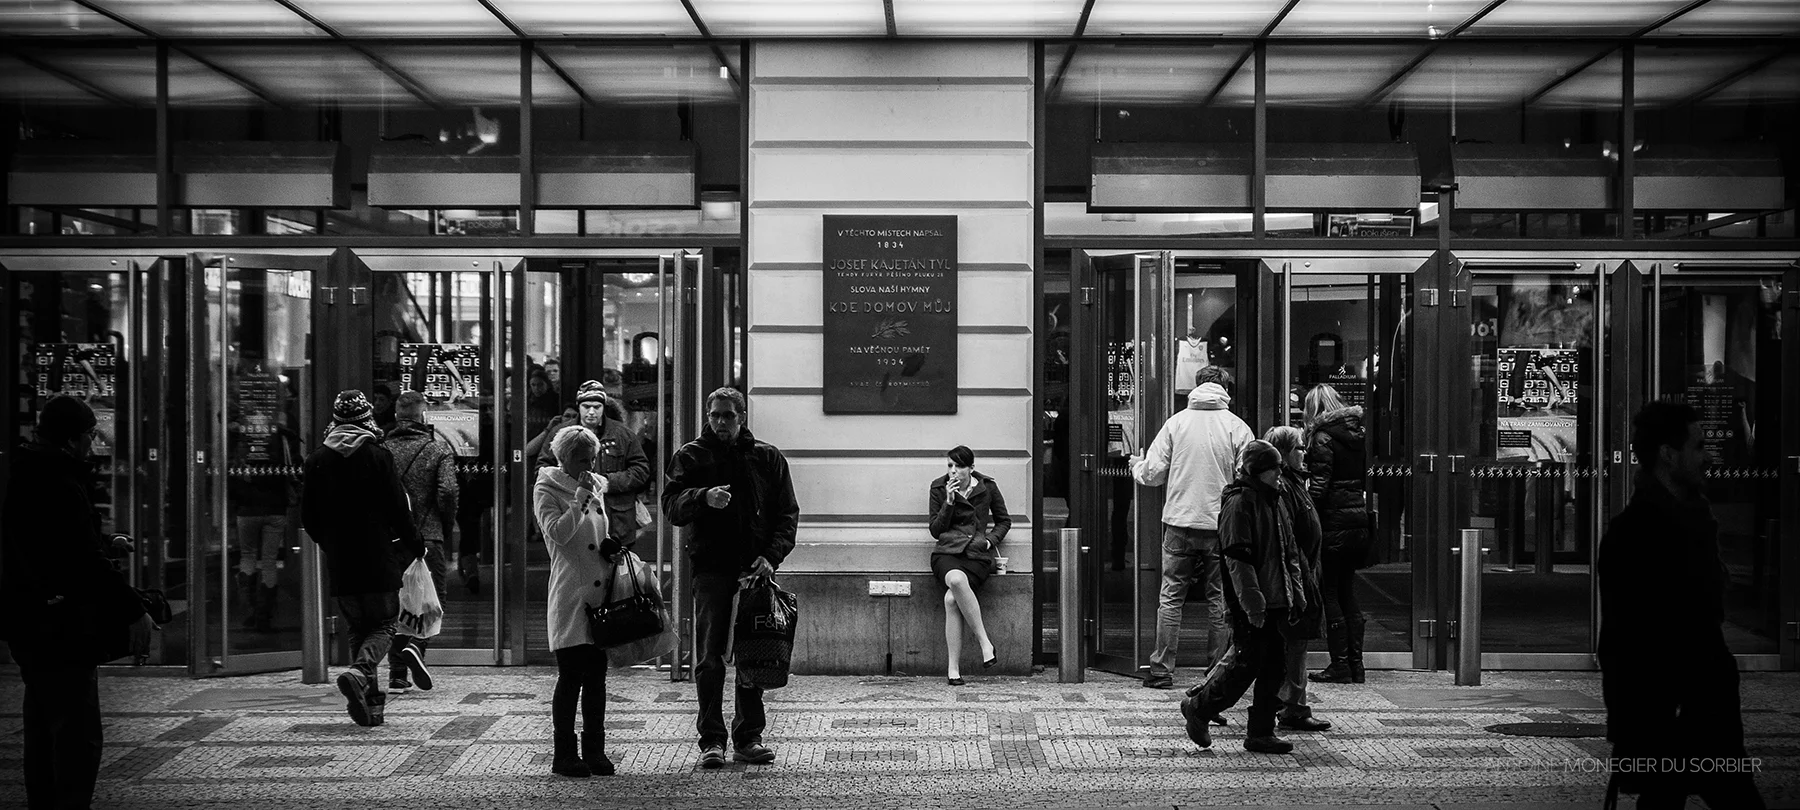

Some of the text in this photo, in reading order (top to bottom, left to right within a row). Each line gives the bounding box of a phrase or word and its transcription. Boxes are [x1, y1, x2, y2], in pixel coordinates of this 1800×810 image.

[830, 258, 951, 270] JOSEF KAJETÁN TYL
[850, 285, 876, 293] SLOVA
[829, 298, 952, 313] KDE DOMOV MŮJ
[850, 346, 862, 354] NA
